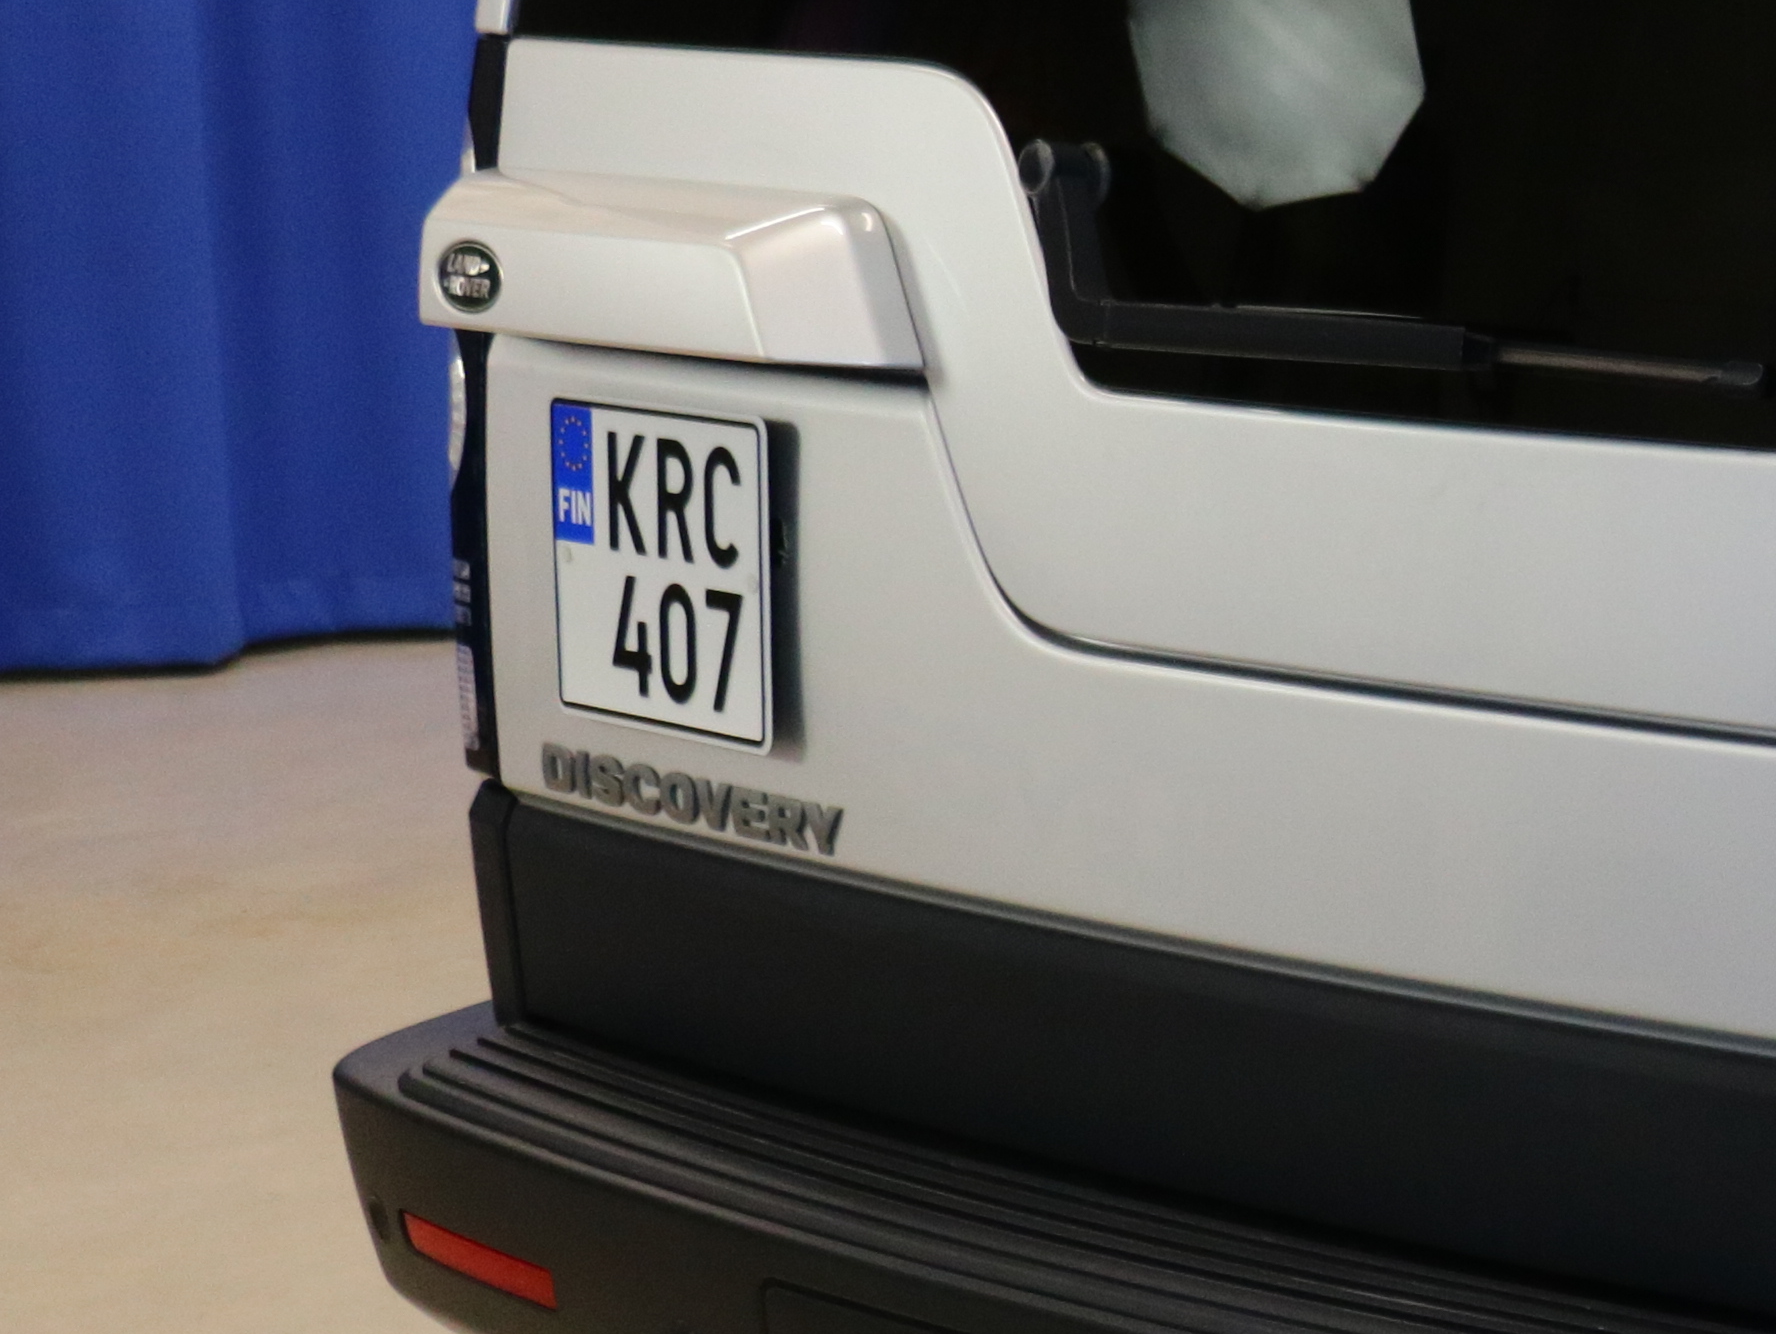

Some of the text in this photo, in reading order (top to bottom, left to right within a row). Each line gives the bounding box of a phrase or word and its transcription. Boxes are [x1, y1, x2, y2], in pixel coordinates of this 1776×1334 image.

[446, 253, 482, 276] LAND
[448, 275, 491, 299] ROVER
[557, 486, 592, 528] FIN
[606, 430, 742, 570] KRC
[612, 574, 743, 713] 407
[541, 741, 844, 857] DISCOVERY
